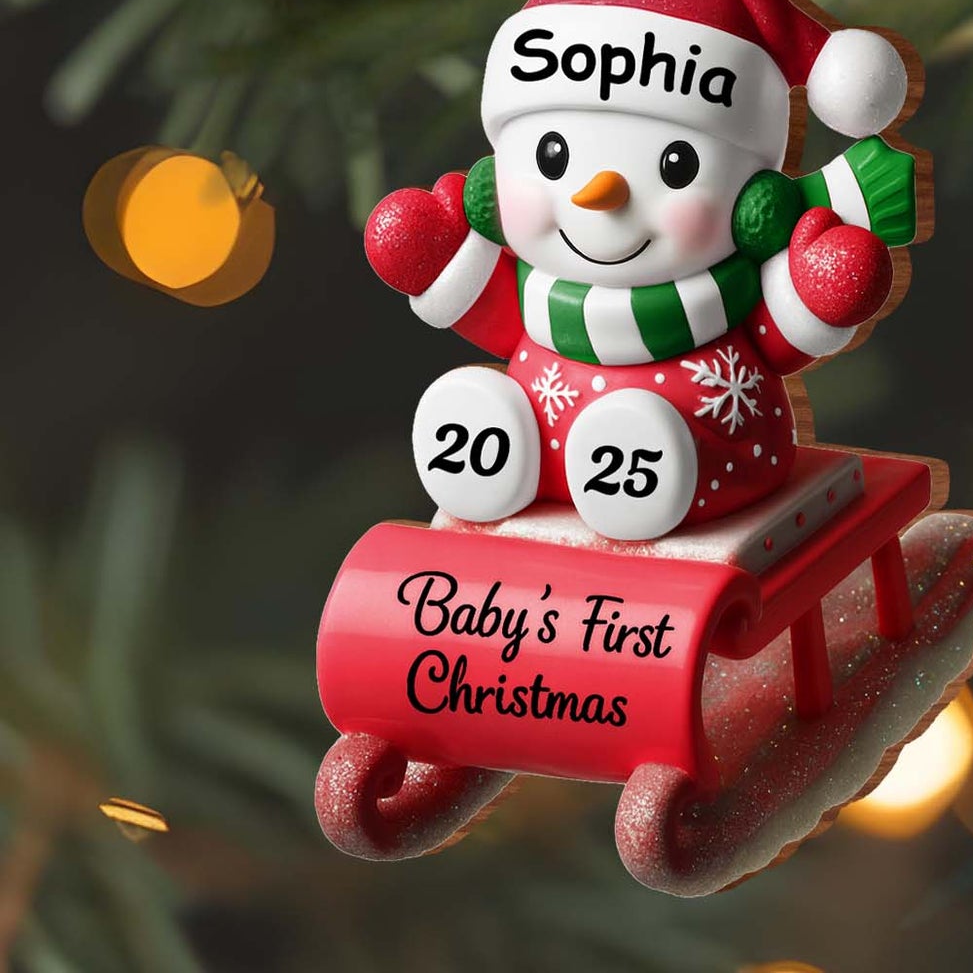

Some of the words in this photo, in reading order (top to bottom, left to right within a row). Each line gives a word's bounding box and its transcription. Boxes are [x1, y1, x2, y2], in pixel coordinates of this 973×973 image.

[510, 28, 738, 109] Sophia
[427, 423, 511, 477] 20
[583, 445, 664, 499] 25
[397, 570, 560, 663] Baby's
[582, 594, 675, 659] First
[406, 649, 628, 728] Christmas
